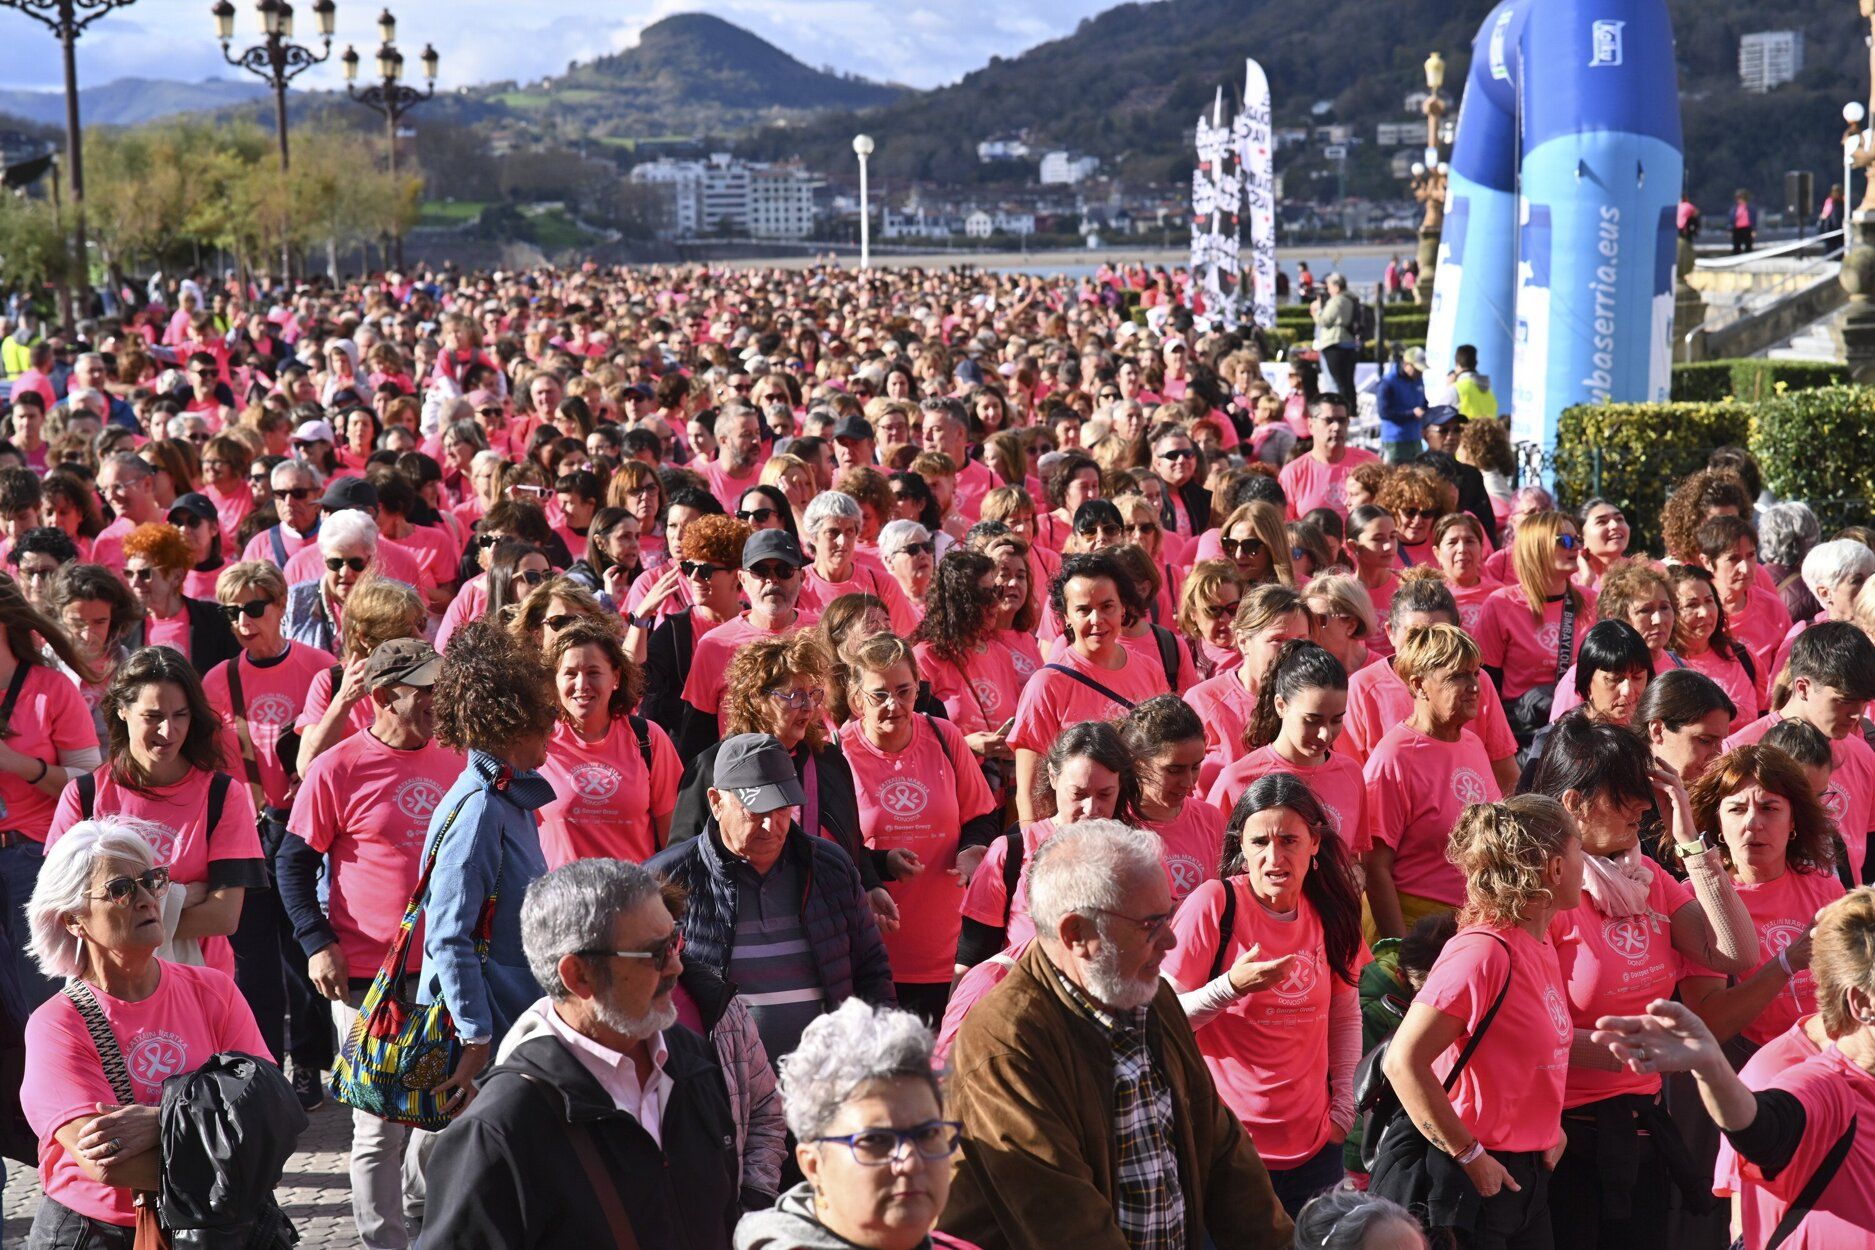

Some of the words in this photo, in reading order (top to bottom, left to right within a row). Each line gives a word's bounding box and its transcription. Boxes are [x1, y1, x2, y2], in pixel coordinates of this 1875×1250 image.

[1278, 995, 1310, 1006] DONOSTIA
[125, 1031, 157, 1053] KATXALIN
[158, 1029, 188, 1050] MARTXA
